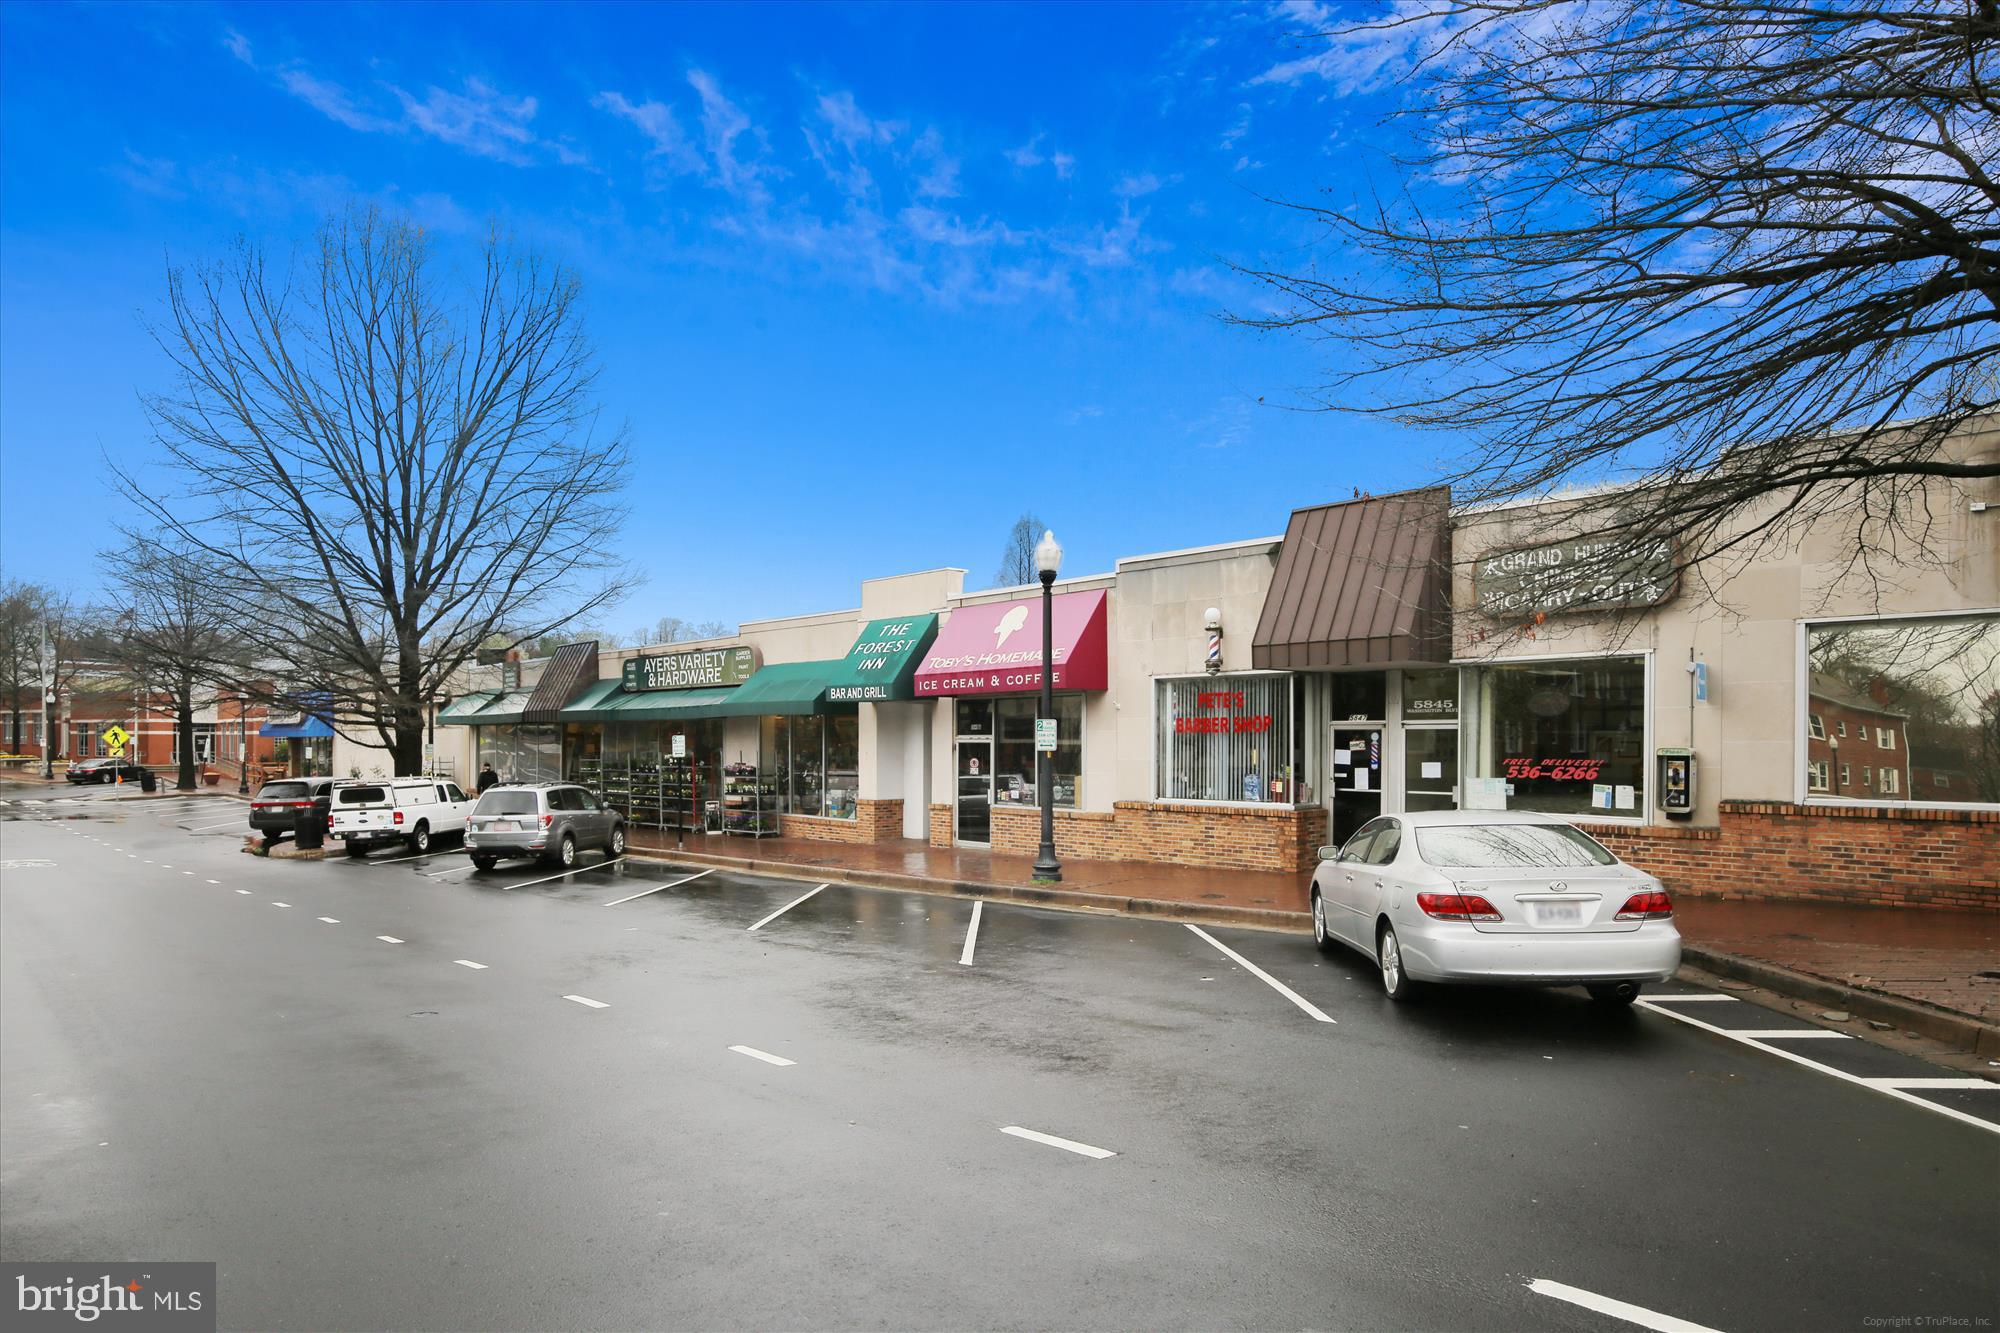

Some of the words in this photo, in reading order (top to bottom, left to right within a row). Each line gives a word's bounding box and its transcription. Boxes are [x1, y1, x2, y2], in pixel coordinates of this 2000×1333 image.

[1501, 548, 1562, 571] GRAND
[1574, 541, 1637, 561] HUN
[880, 623, 913, 637] THE
[854, 640, 916, 655] FOREST
[643, 656, 677, 673] AYERS
[678, 651, 727, 670] VARIETY
[858, 657, 887, 670] INN
[648, 672, 656, 687] &
[657, 667, 722, 687] HARDWARE
[919, 680, 938, 691] ICE
[943, 678, 984, 689] CREAM
[991, 675, 1000, 686] &
[1006, 672, 1060, 685] COFFE
[830, 688, 846, 699] BAR
[847, 687, 862, 698] AND
[864, 686, 887, 698] GRILL
[1197, 690, 1244, 709] PETE'S
[1413, 699, 1453, 709] 5845
[1037, 721, 1043, 731] 2
[1175, 717, 1230, 735] BARBER
[1233, 715, 1273, 733] SHOP
[1503, 758, 1534, 766] FREE
[1541, 758, 1606, 767] DELIVERY!
[1506, 765, 1599, 781] 536-6266
